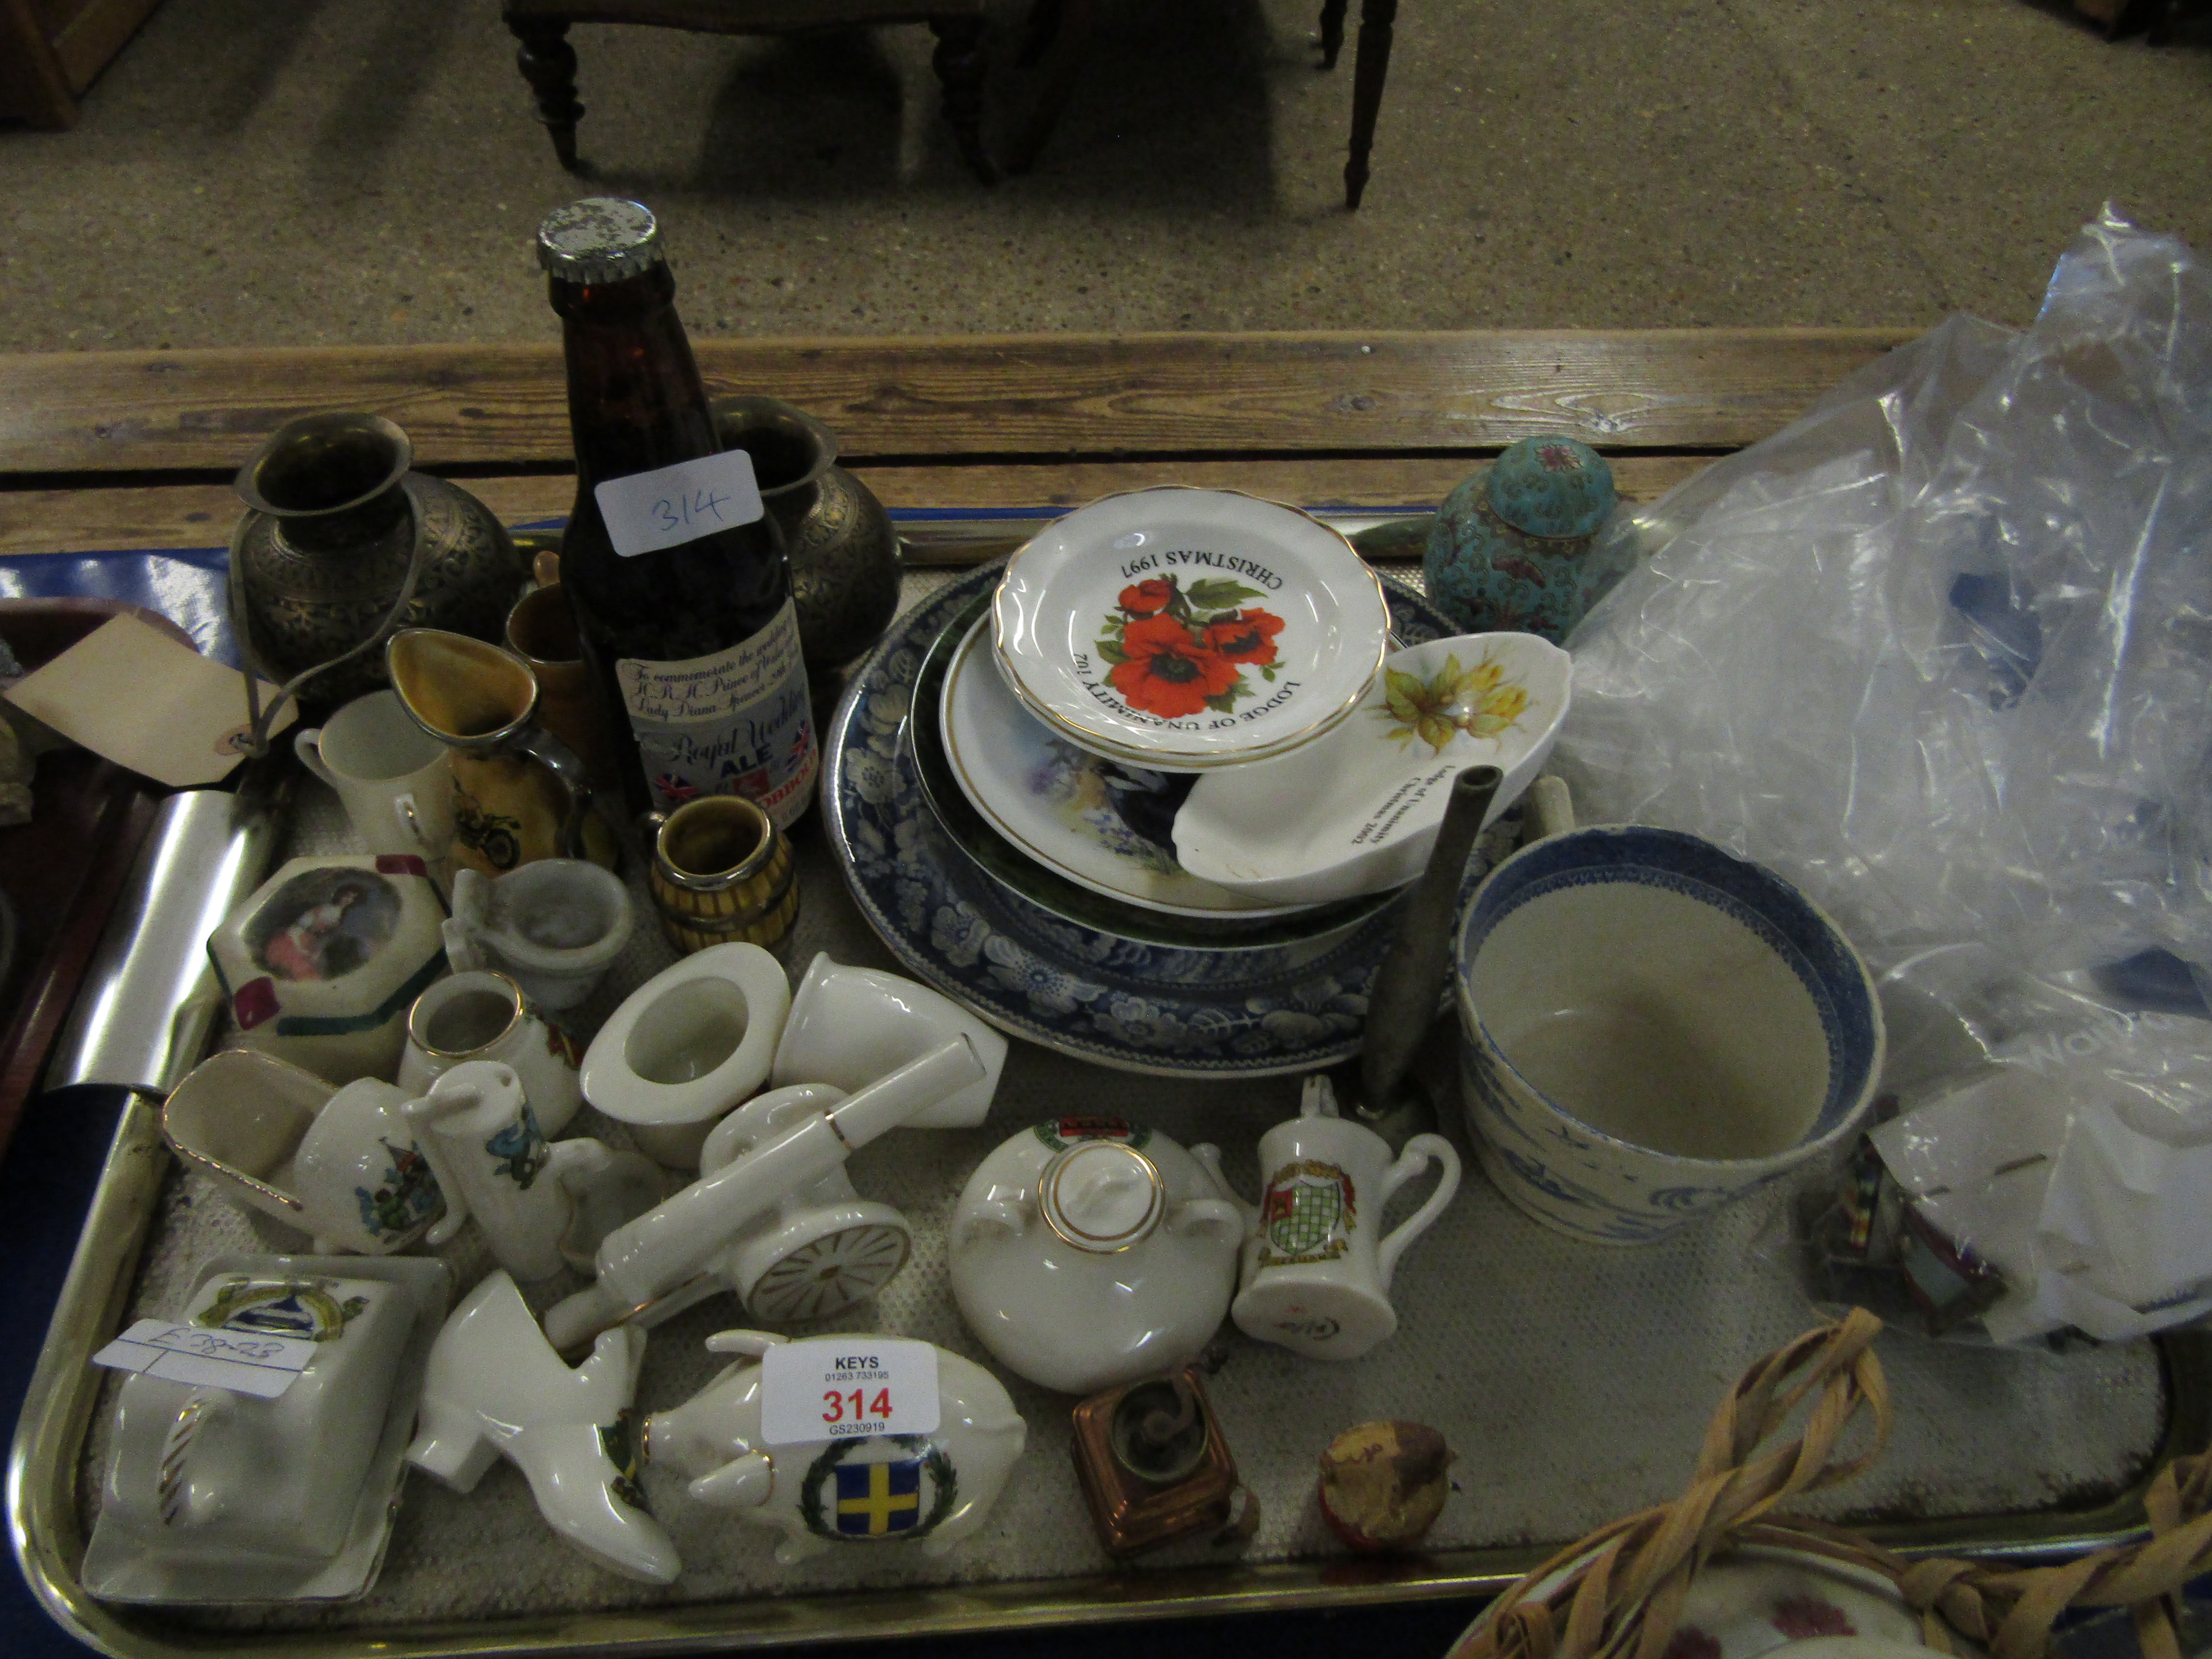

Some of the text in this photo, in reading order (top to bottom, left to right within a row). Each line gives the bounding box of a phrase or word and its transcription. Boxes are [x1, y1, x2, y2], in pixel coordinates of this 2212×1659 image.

[652, 490, 731, 531] 314
[1120, 550, 1283, 590] CHRISTMAS 1997
[653, 661, 737, 683] commemorate
[738, 650, 754, 666] the
[1082, 680, 1200, 731] UNANIMITY
[1240, 680, 1302, 722] LODGE
[1209, 717, 1237, 730] OF
[668, 728, 737, 769] Royal
[720, 743, 772, 778] ALE
[825, 1372, 853, 1382] 01263
[835, 1356, 879, 1370] KEYS
[822, 1387, 893, 1423] 314
[829, 1422, 885, 1436] GS230919
